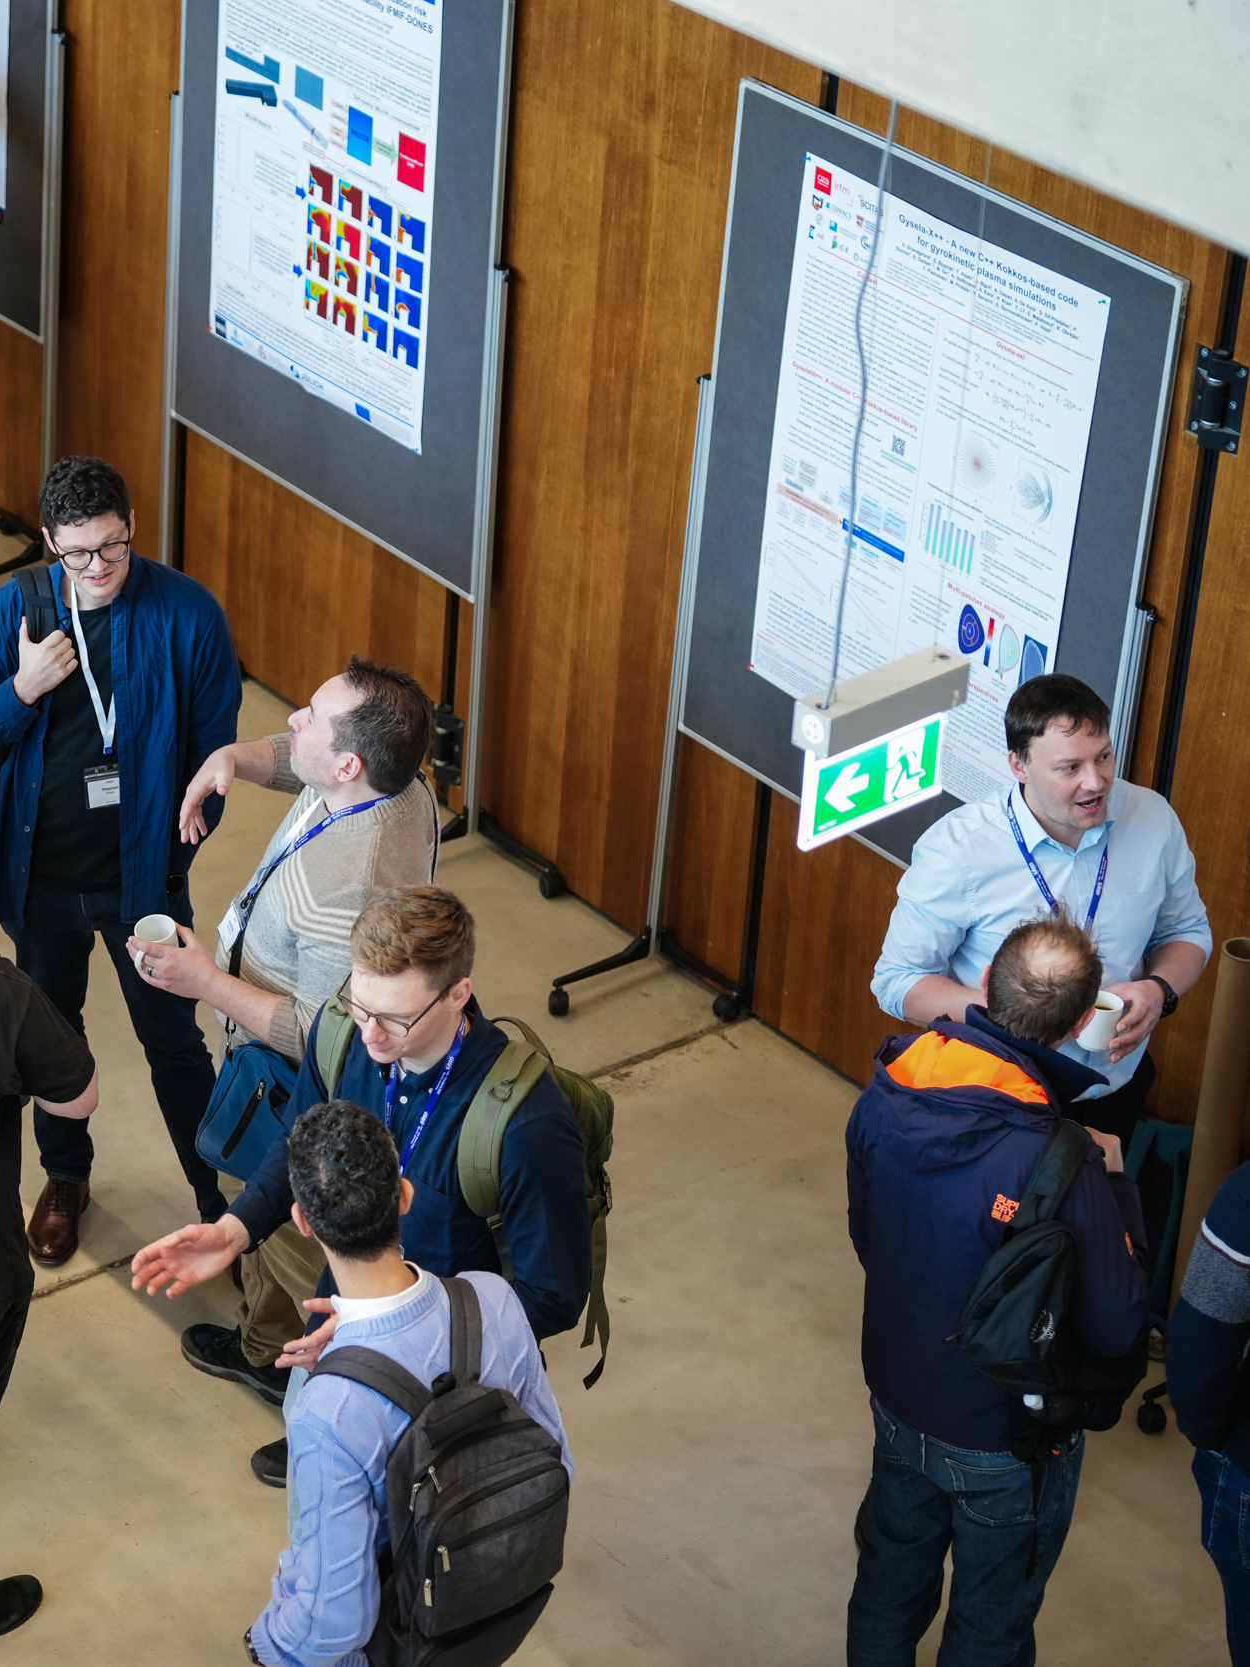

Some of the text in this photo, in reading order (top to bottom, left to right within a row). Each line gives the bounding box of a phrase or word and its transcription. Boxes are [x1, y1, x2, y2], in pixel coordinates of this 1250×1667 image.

[387, 4, 433, 34] IFMIF-DONES
[414, 5, 427, 18] risk
[834, 180, 850, 196] irfm
[899, 214, 944, 242] Gysela-X++
[950, 239, 958, 249] A
[959, 244, 976, 258] new
[977, 252, 994, 266] C++
[995, 260, 1056, 297] Kokkos-based
[1057, 290, 1080, 308] code
[917, 235, 929, 248] for
[930, 243, 975, 271] gyrokinetic
[976, 266, 1007, 286] plasma
[1008, 281, 1056, 311] simulations
[857, 271, 878, 286] Cotext
[996, 341, 1026, 360] Gysela-axi
[830, 381, 852, 396] modular
[864, 398, 901, 422] Kokkos-based
[901, 416, 918, 432] library
[947, 581, 1006, 621] Multi-patches strategy
[967, 680, 999, 704] erspectives
